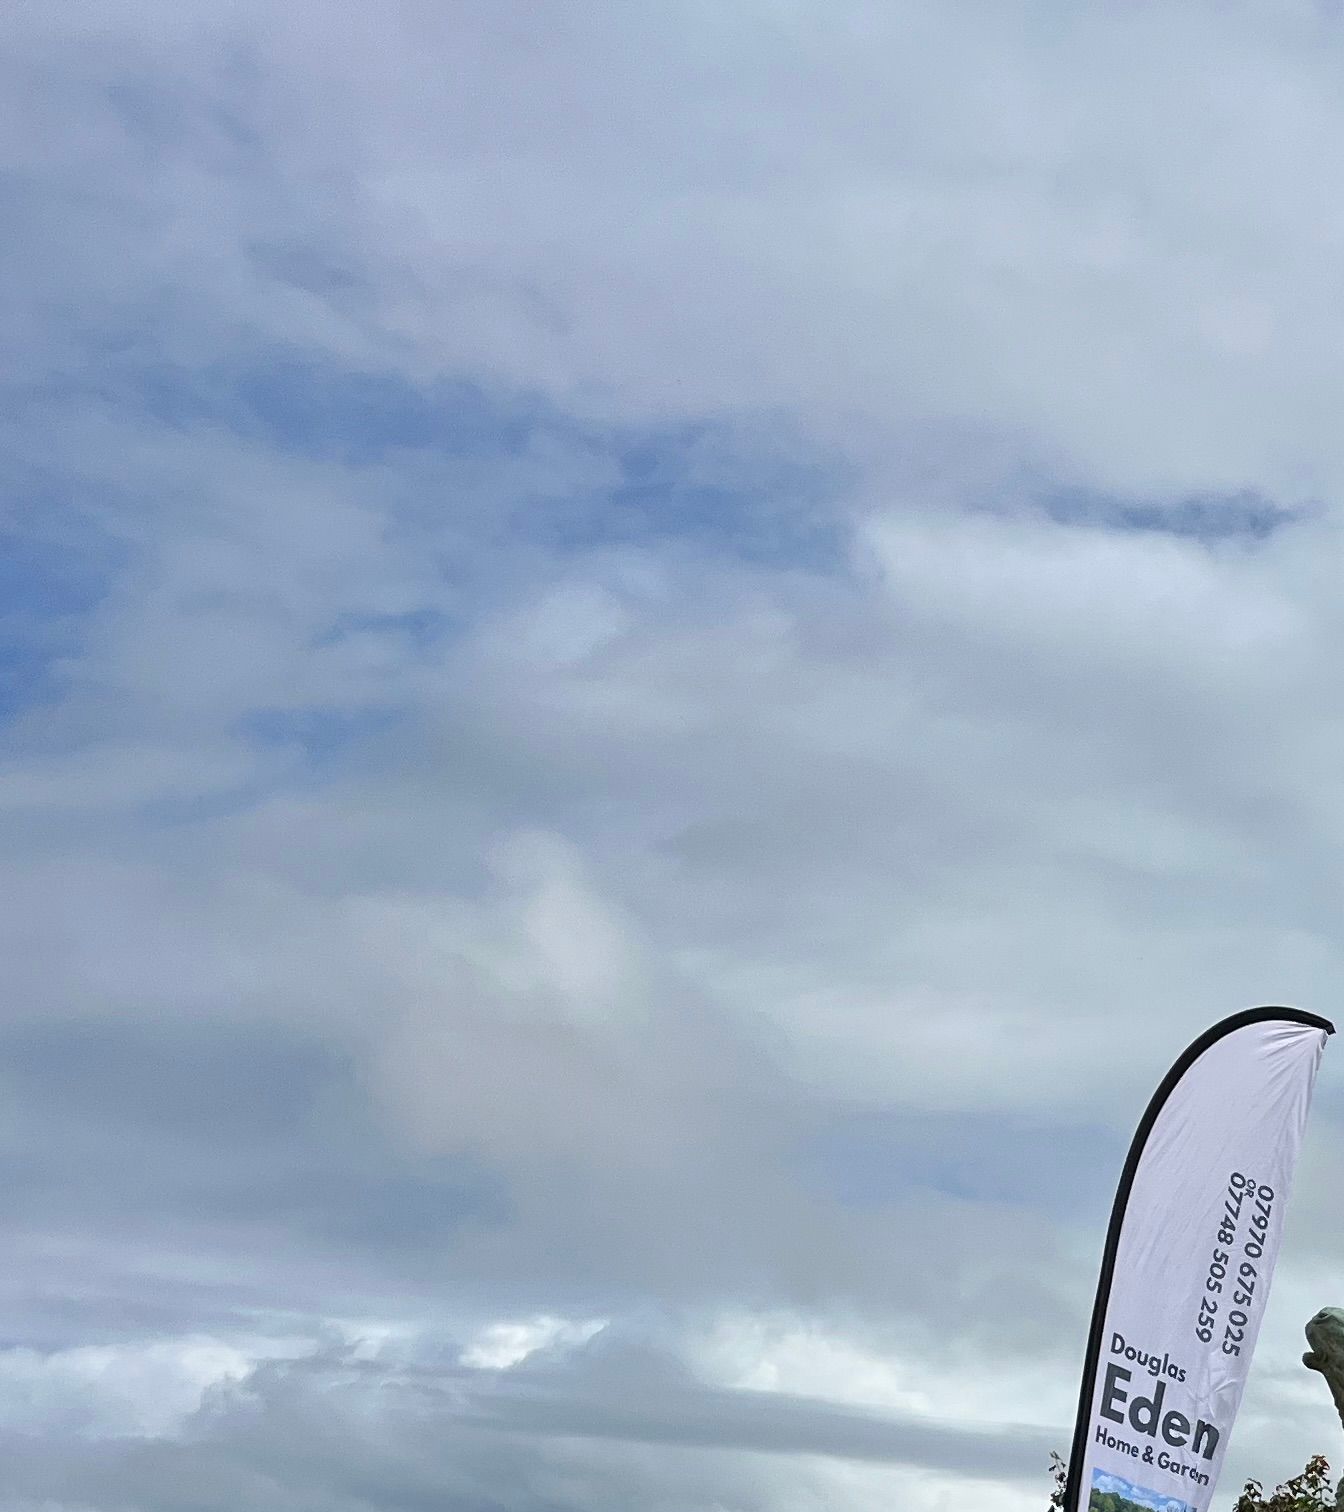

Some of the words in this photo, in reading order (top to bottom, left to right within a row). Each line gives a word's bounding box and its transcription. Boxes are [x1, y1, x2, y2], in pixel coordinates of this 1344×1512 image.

[1217, 1171, 1246, 1246] 07748
[1244, 1179, 1257, 1199] OR
[1244, 1184, 1275, 1259] 07970
[1206, 1248, 1229, 1294] 505
[1232, 1262, 1257, 1307] 675
[1195, 1296, 1218, 1343] 259
[1222, 1310, 1248, 1357] 025
[1110, 1332, 1187, 1382] Douglas
[1100, 1361, 1220, 1461] Eden
[1095, 1425, 1139, 1458] Home
[1142, 1445, 1154, 1465] &
